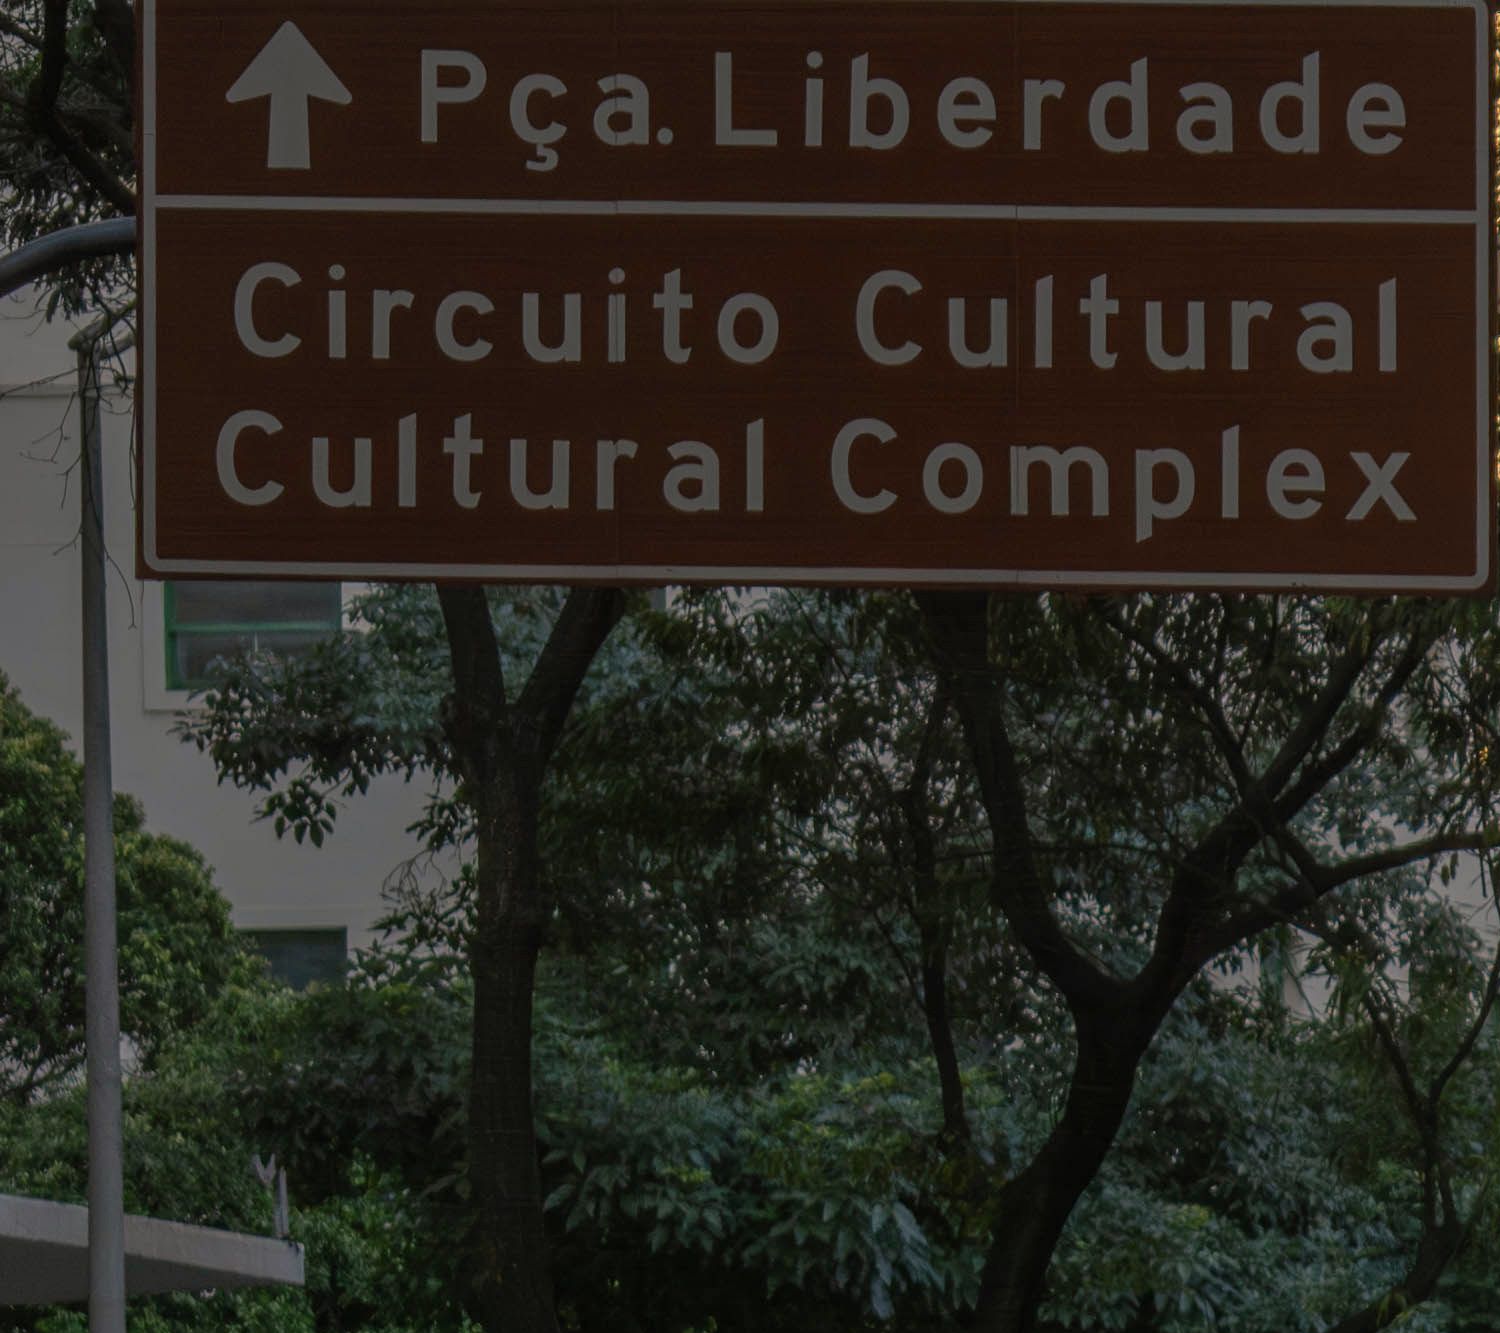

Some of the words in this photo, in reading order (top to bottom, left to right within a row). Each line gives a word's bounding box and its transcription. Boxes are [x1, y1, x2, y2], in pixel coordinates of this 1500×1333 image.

[421, 48, 674, 173] Pça.
[714, 50, 1407, 156] Liberdade
[233, 261, 780, 366] Circuito
[855, 269, 1398, 375] Cultural
[215, 409, 764, 514] Cultural
[830, 418, 1417, 543] Complex
